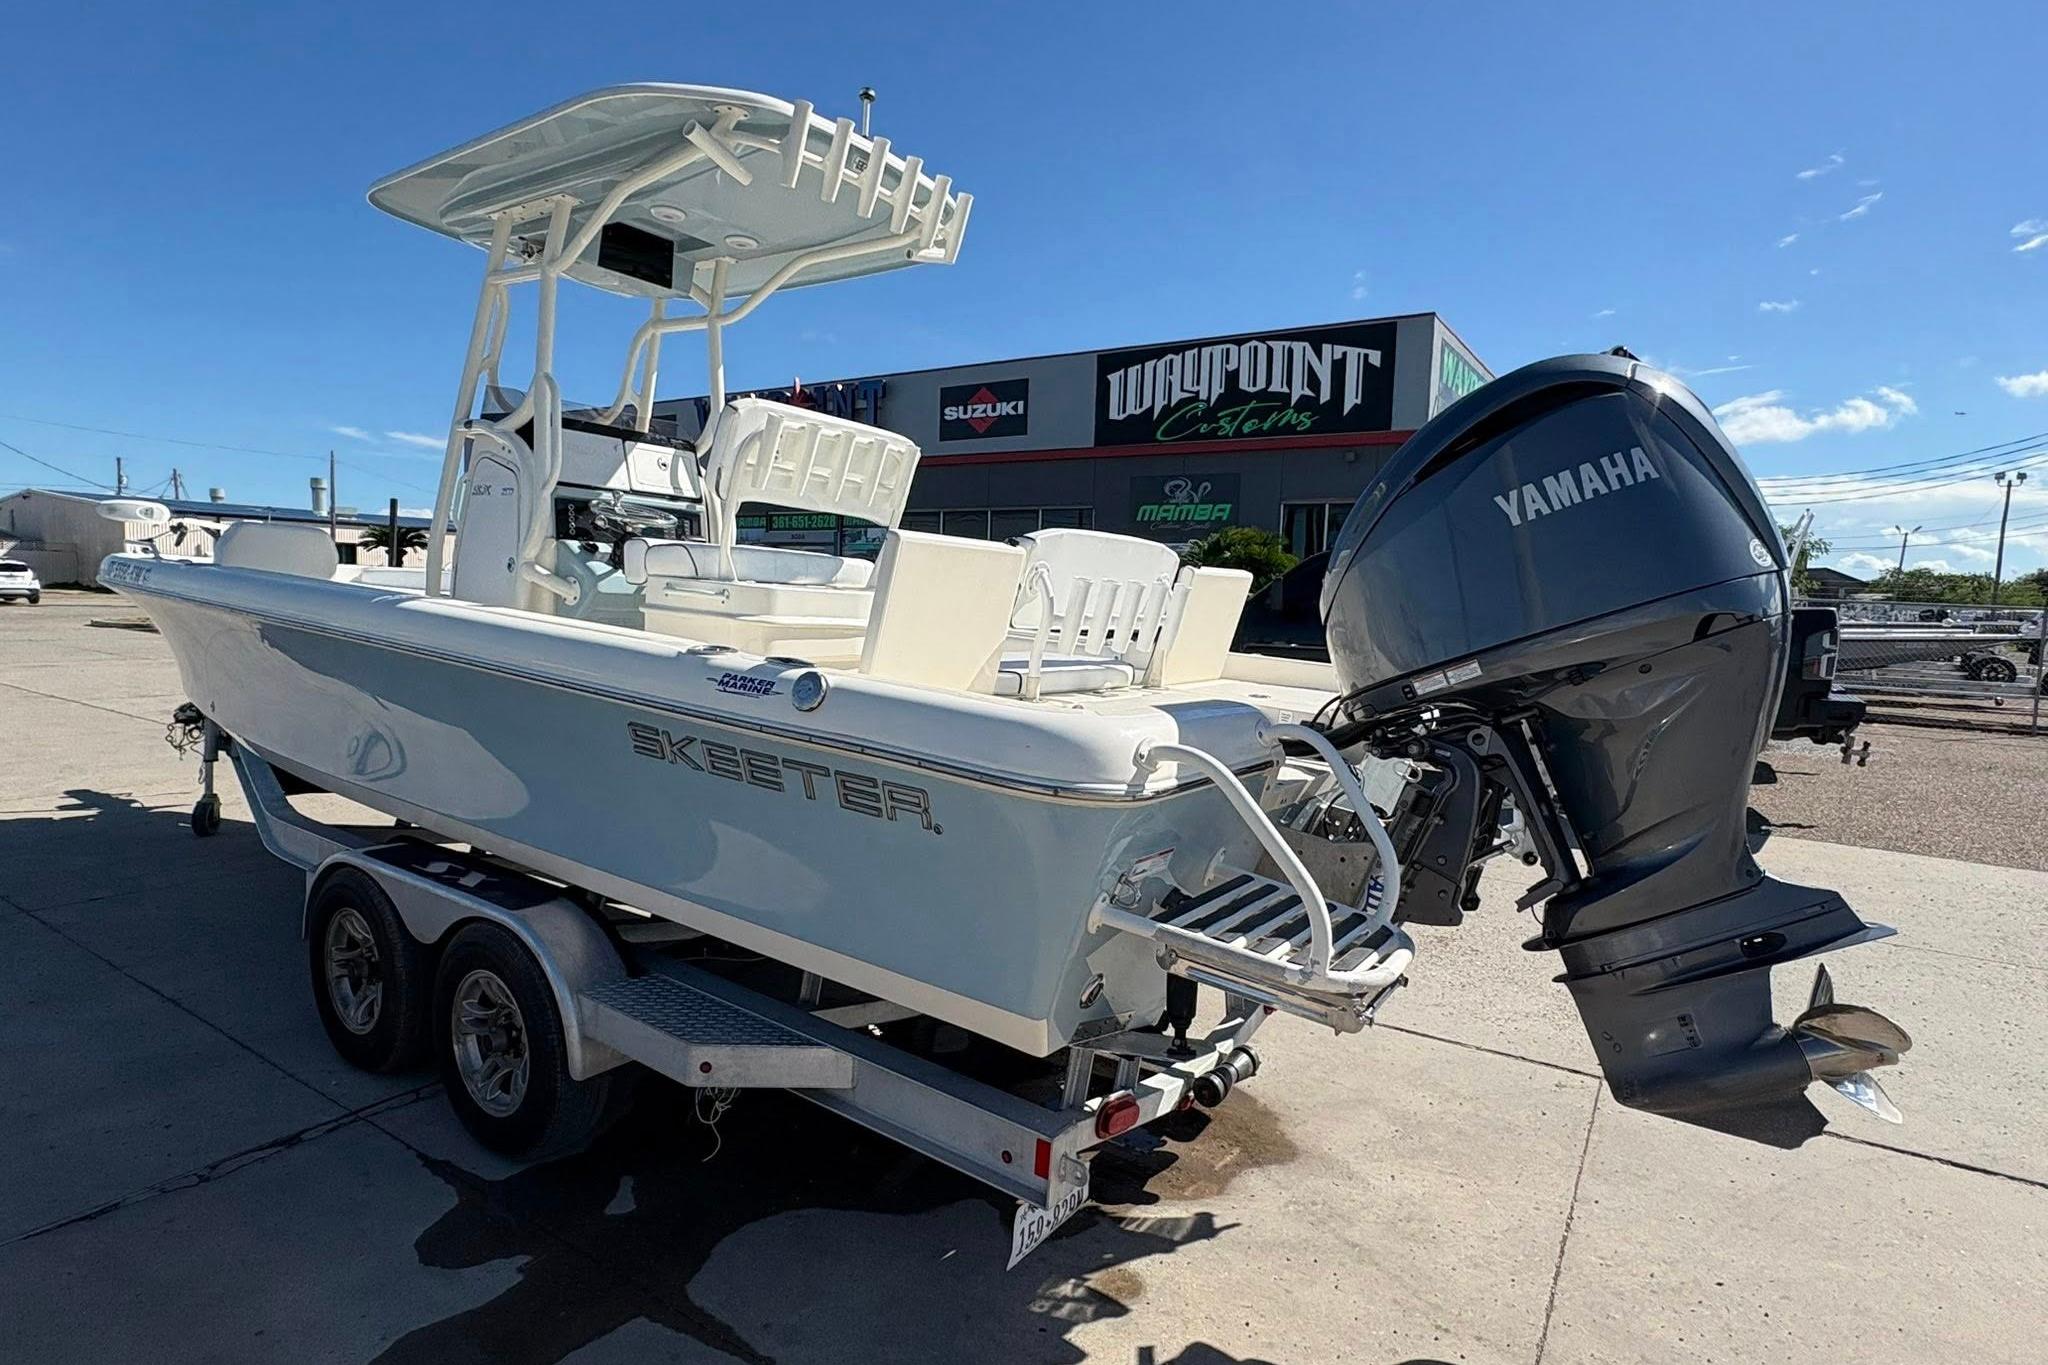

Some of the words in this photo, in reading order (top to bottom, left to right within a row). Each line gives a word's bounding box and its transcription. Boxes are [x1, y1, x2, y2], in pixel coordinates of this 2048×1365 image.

[1107, 340, 1381, 420] WAYPOINT
[944, 400, 1024, 421] SUZUKI
[1156, 401, 1320, 441] Customs
[1494, 447, 1660, 527] YAMAHA
[1136, 503, 1232, 521] MAMBA
[717, 679, 772, 696] MARINE
[721, 672, 776, 688] PARKER
